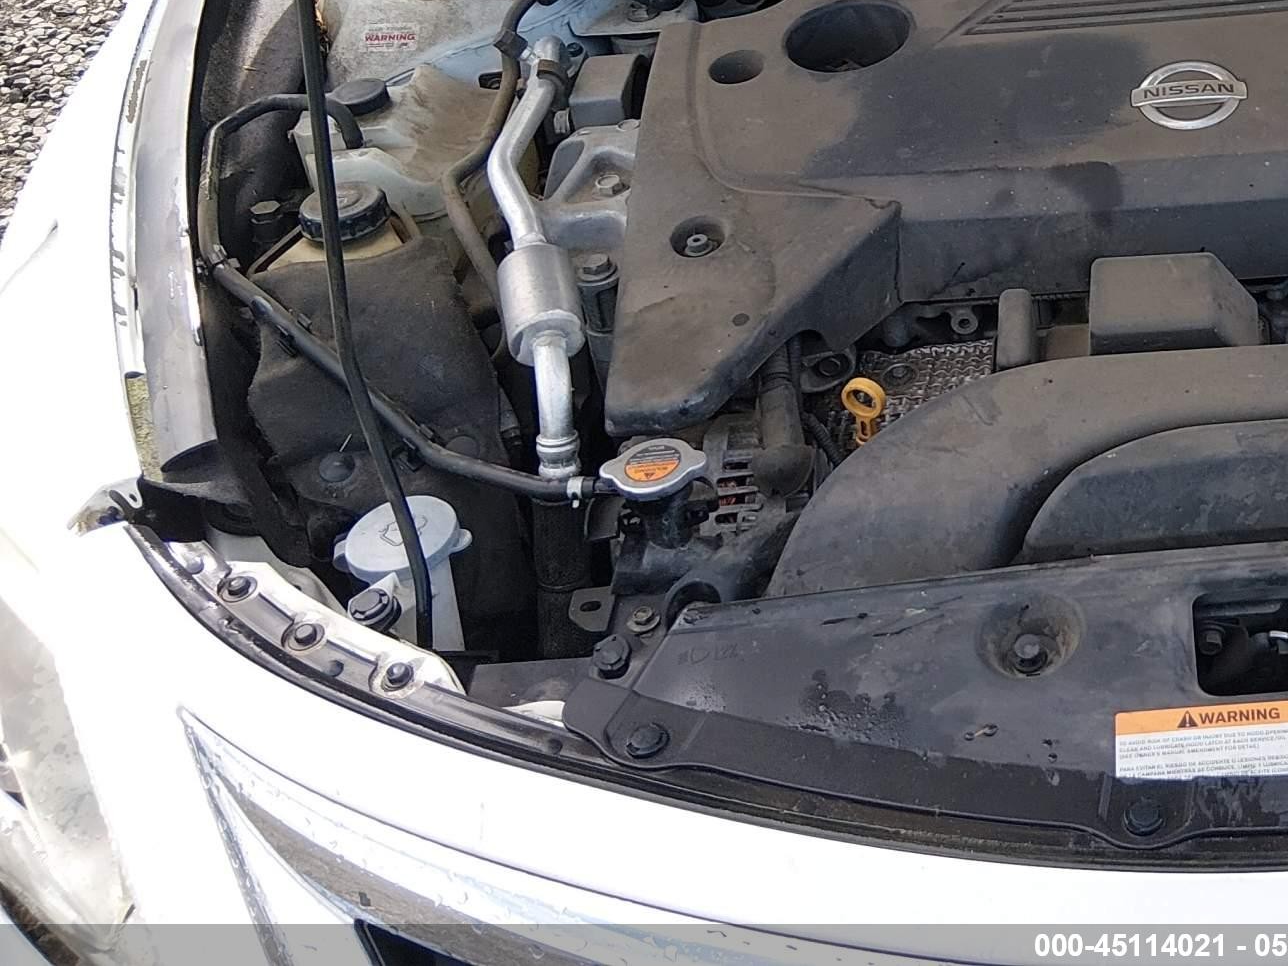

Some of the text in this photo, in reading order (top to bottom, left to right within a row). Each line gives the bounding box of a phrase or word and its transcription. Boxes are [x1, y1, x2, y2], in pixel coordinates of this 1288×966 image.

[365, 33, 416, 42] WARNING
[1143, 82, 1234, 99] NISSAN
[1198, 707, 1281, 725] WARNING
